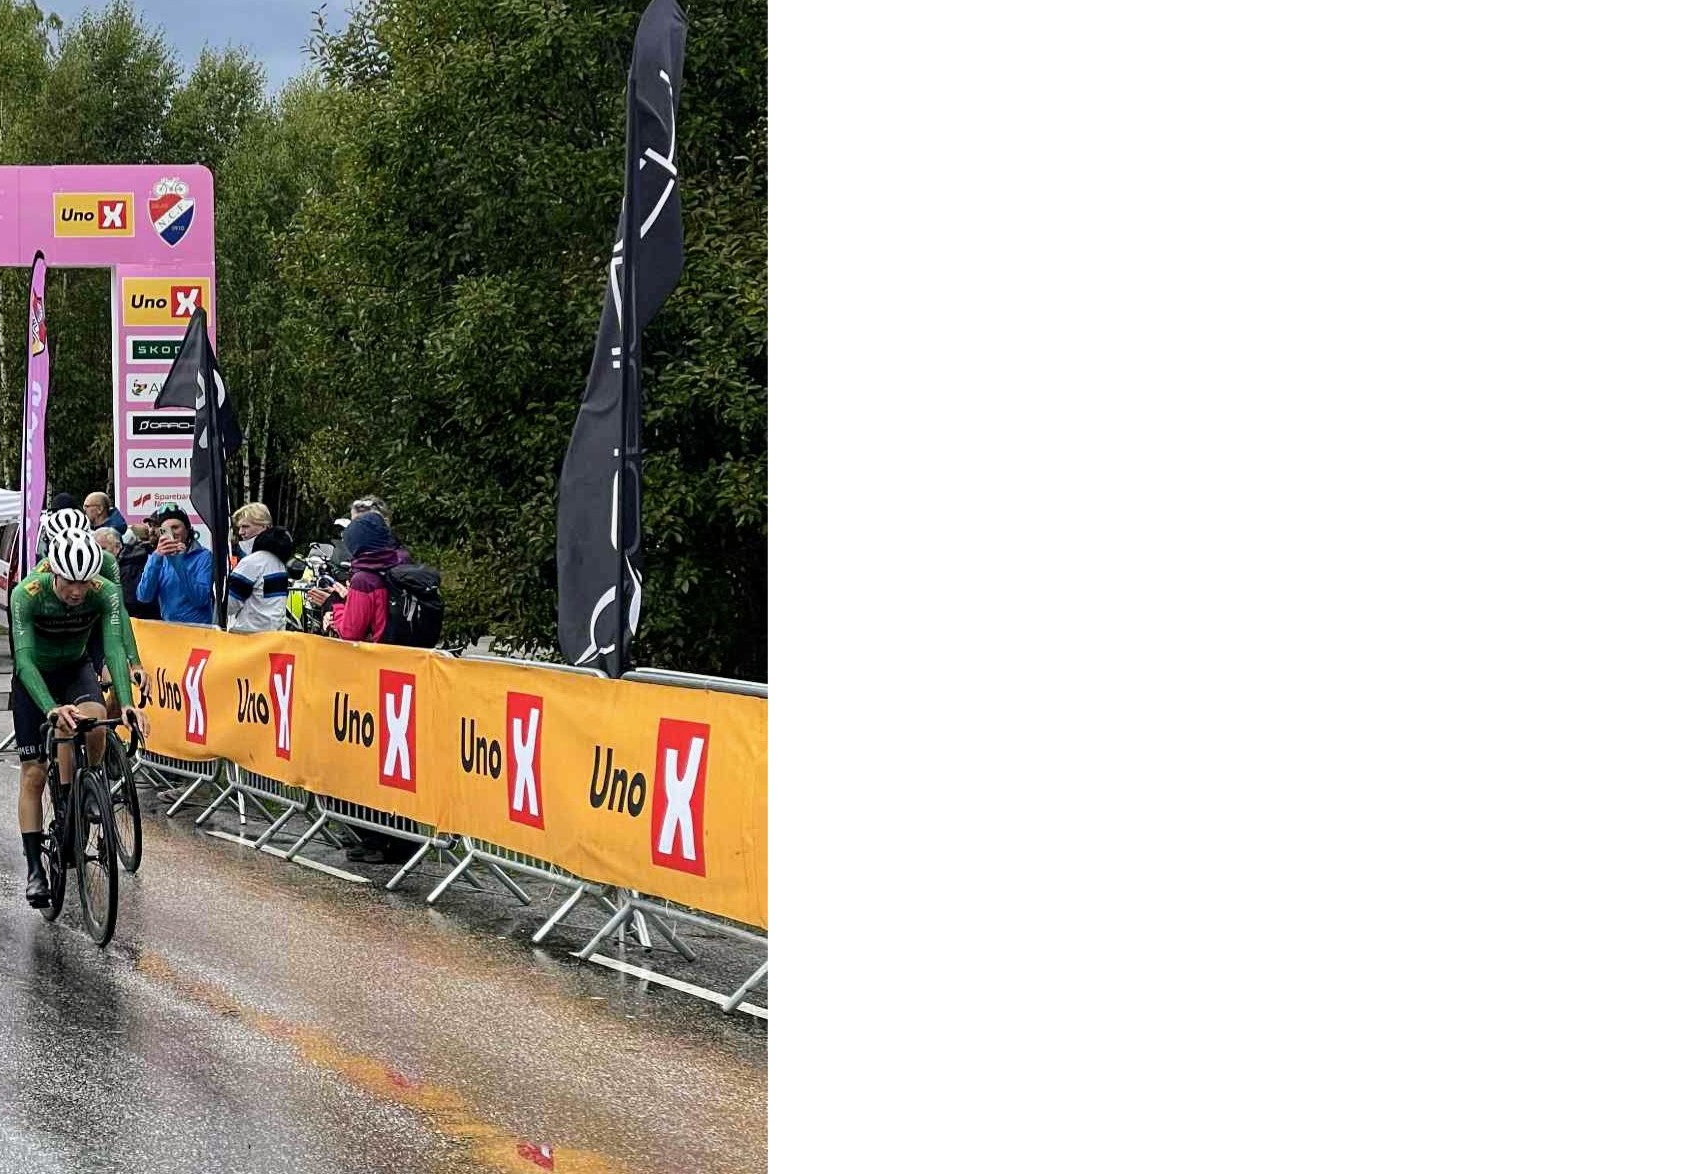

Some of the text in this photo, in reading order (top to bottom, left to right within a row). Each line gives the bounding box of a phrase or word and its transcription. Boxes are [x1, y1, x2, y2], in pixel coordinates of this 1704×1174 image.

[61, 202, 124, 228] Uno X
[131, 289, 198, 316] Uno X
[133, 457, 192, 469] GARMI
[156, 658, 207, 736] Uno X
[237, 664, 292, 751] Uno X
[334, 684, 413, 781] Uno X
[461, 707, 540, 816] Uno X
[589, 737, 705, 861] Uno X
